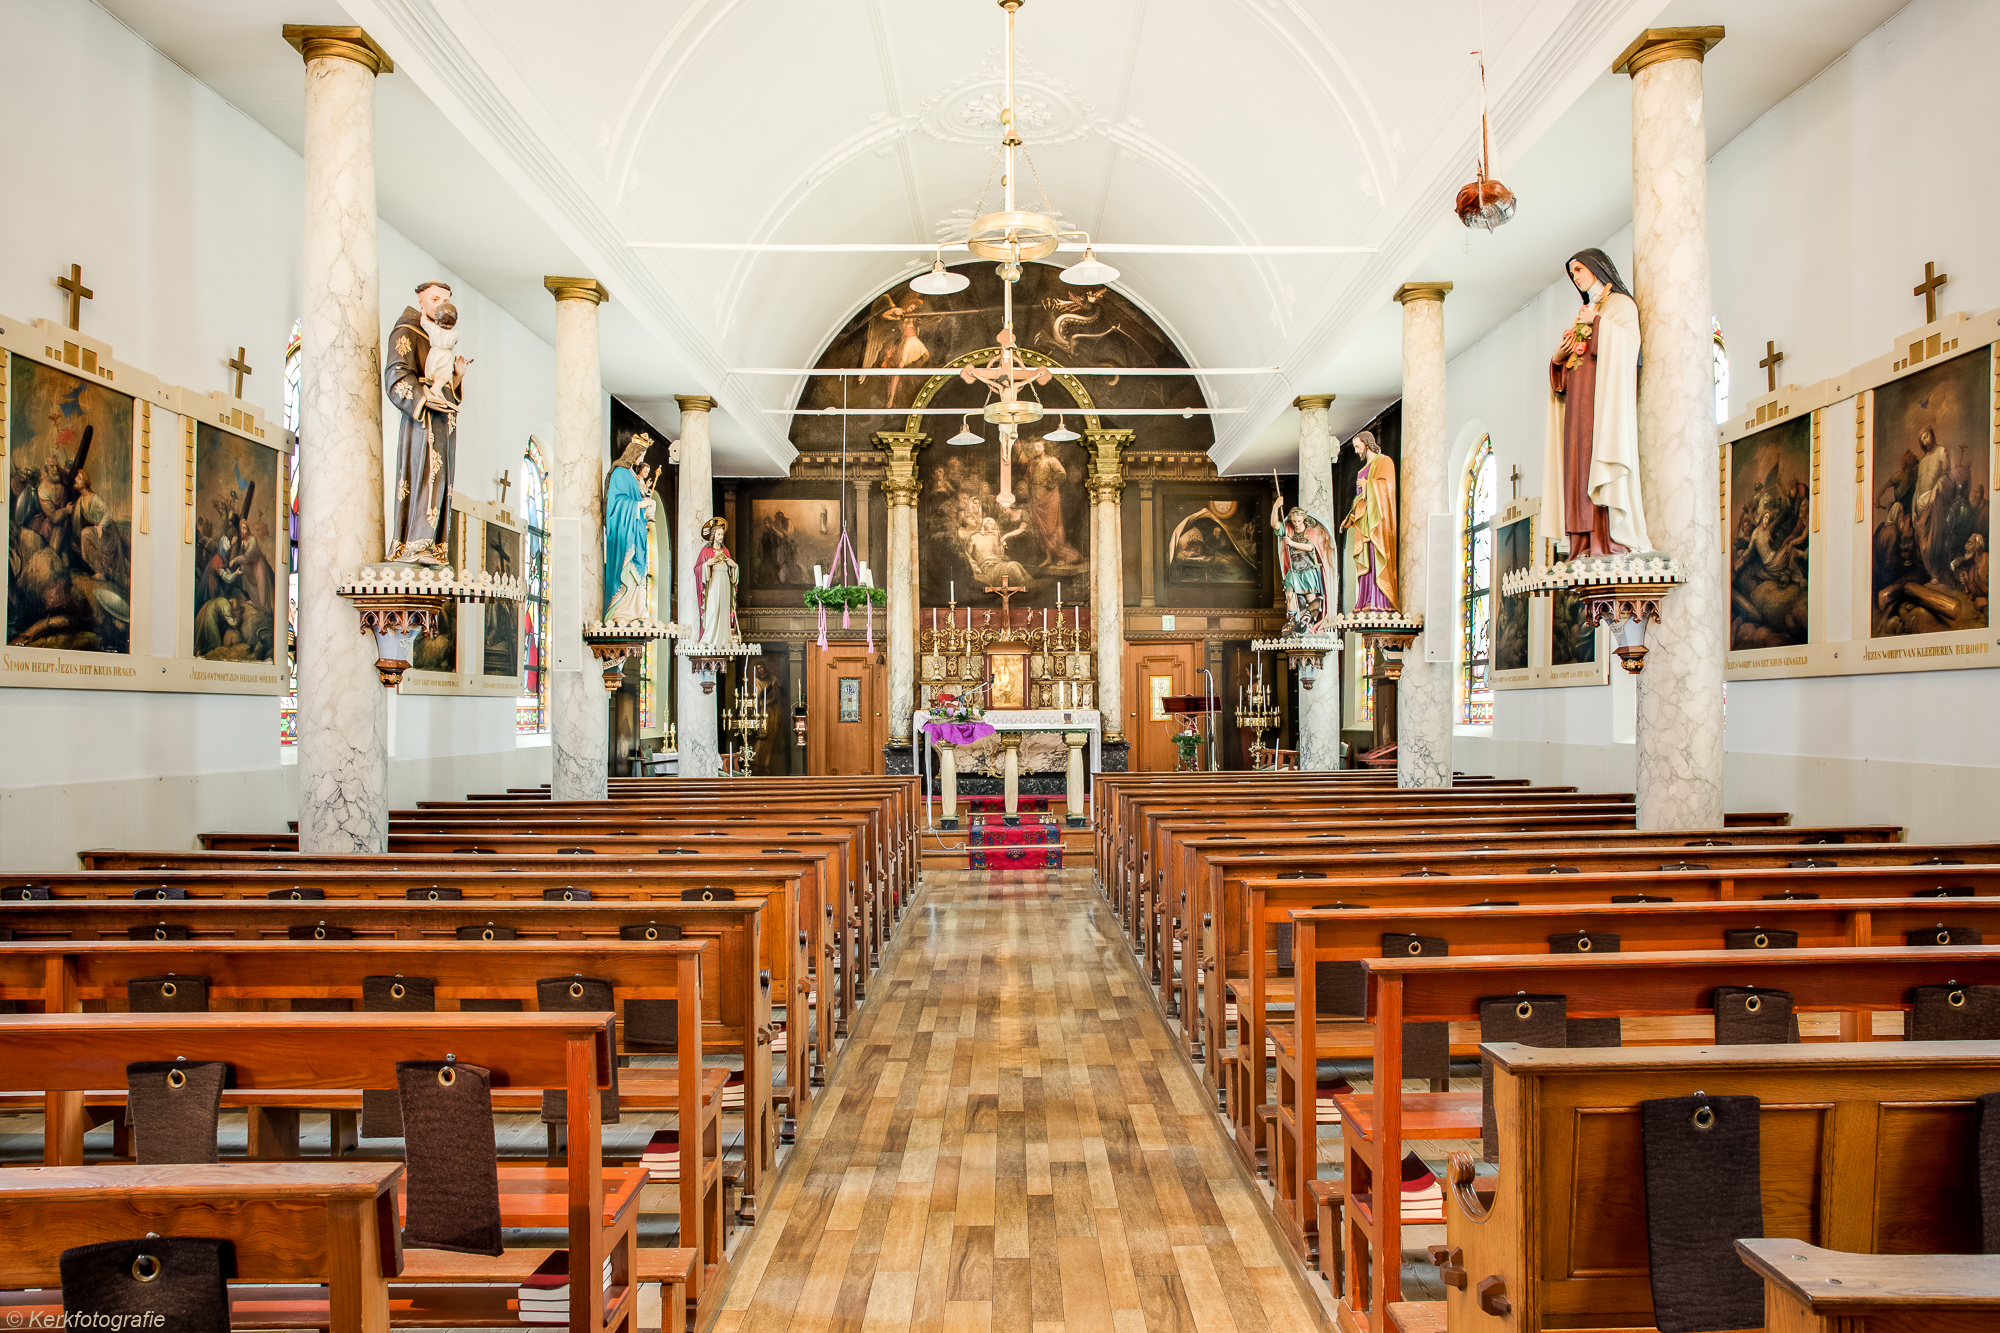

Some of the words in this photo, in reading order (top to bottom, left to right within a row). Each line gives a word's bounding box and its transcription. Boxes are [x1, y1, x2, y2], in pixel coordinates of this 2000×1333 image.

[1863, 645, 1882, 661] JEZUS
[1881, 649, 1902, 660] WORDT
[1902, 647, 1916, 659] VAN
[1916, 644, 1953, 658] KLEEDEREN
[1955, 642, 1989, 655] BEROOFD
[2, 653, 30, 672] SIMON
[31, 661, 55, 673] HELPT
[55, 656, 78, 674] JEZUS
[79, 664, 93, 675] HET
[93, 665, 112, 676] KRUIS
[113, 666, 137, 677] DRAGEN
[1724, 656, 1738, 670] JEZUS
[1769, 658, 1783, 667] KRUIS
[1783, 655, 1808, 666] GENAGELD
[189, 666, 207, 680] JEZUS
